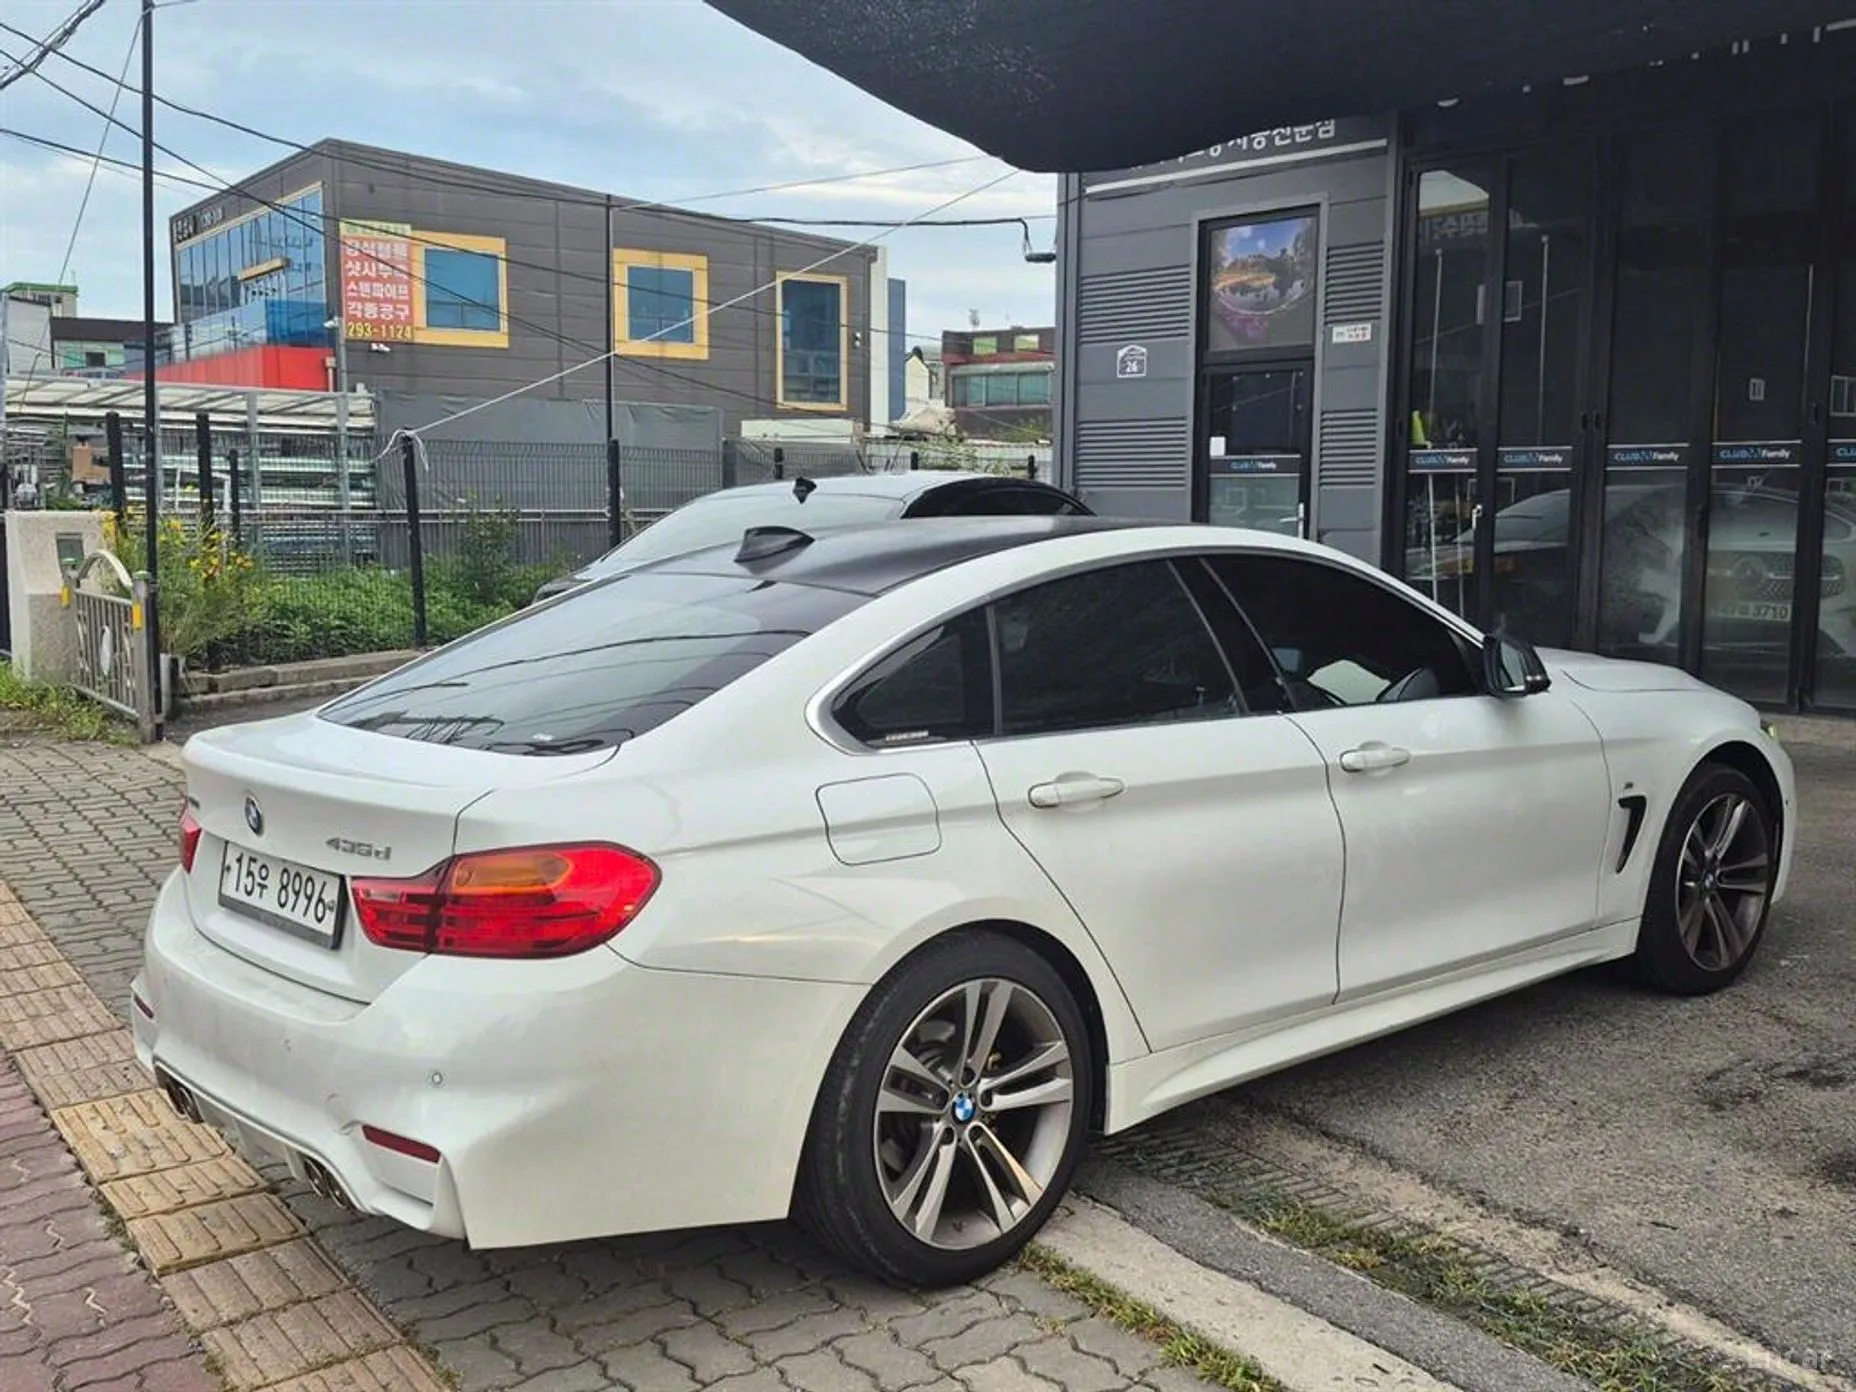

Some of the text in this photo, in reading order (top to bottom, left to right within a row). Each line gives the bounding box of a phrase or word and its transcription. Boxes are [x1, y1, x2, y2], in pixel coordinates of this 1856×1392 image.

[346, 301, 409, 321] 각종공구
[347, 321, 412, 339] 293-1124
[1651, 449, 1680, 463] Family
[1761, 447, 1791, 461] Family
[235, 851, 327, 924] 15우 8996
